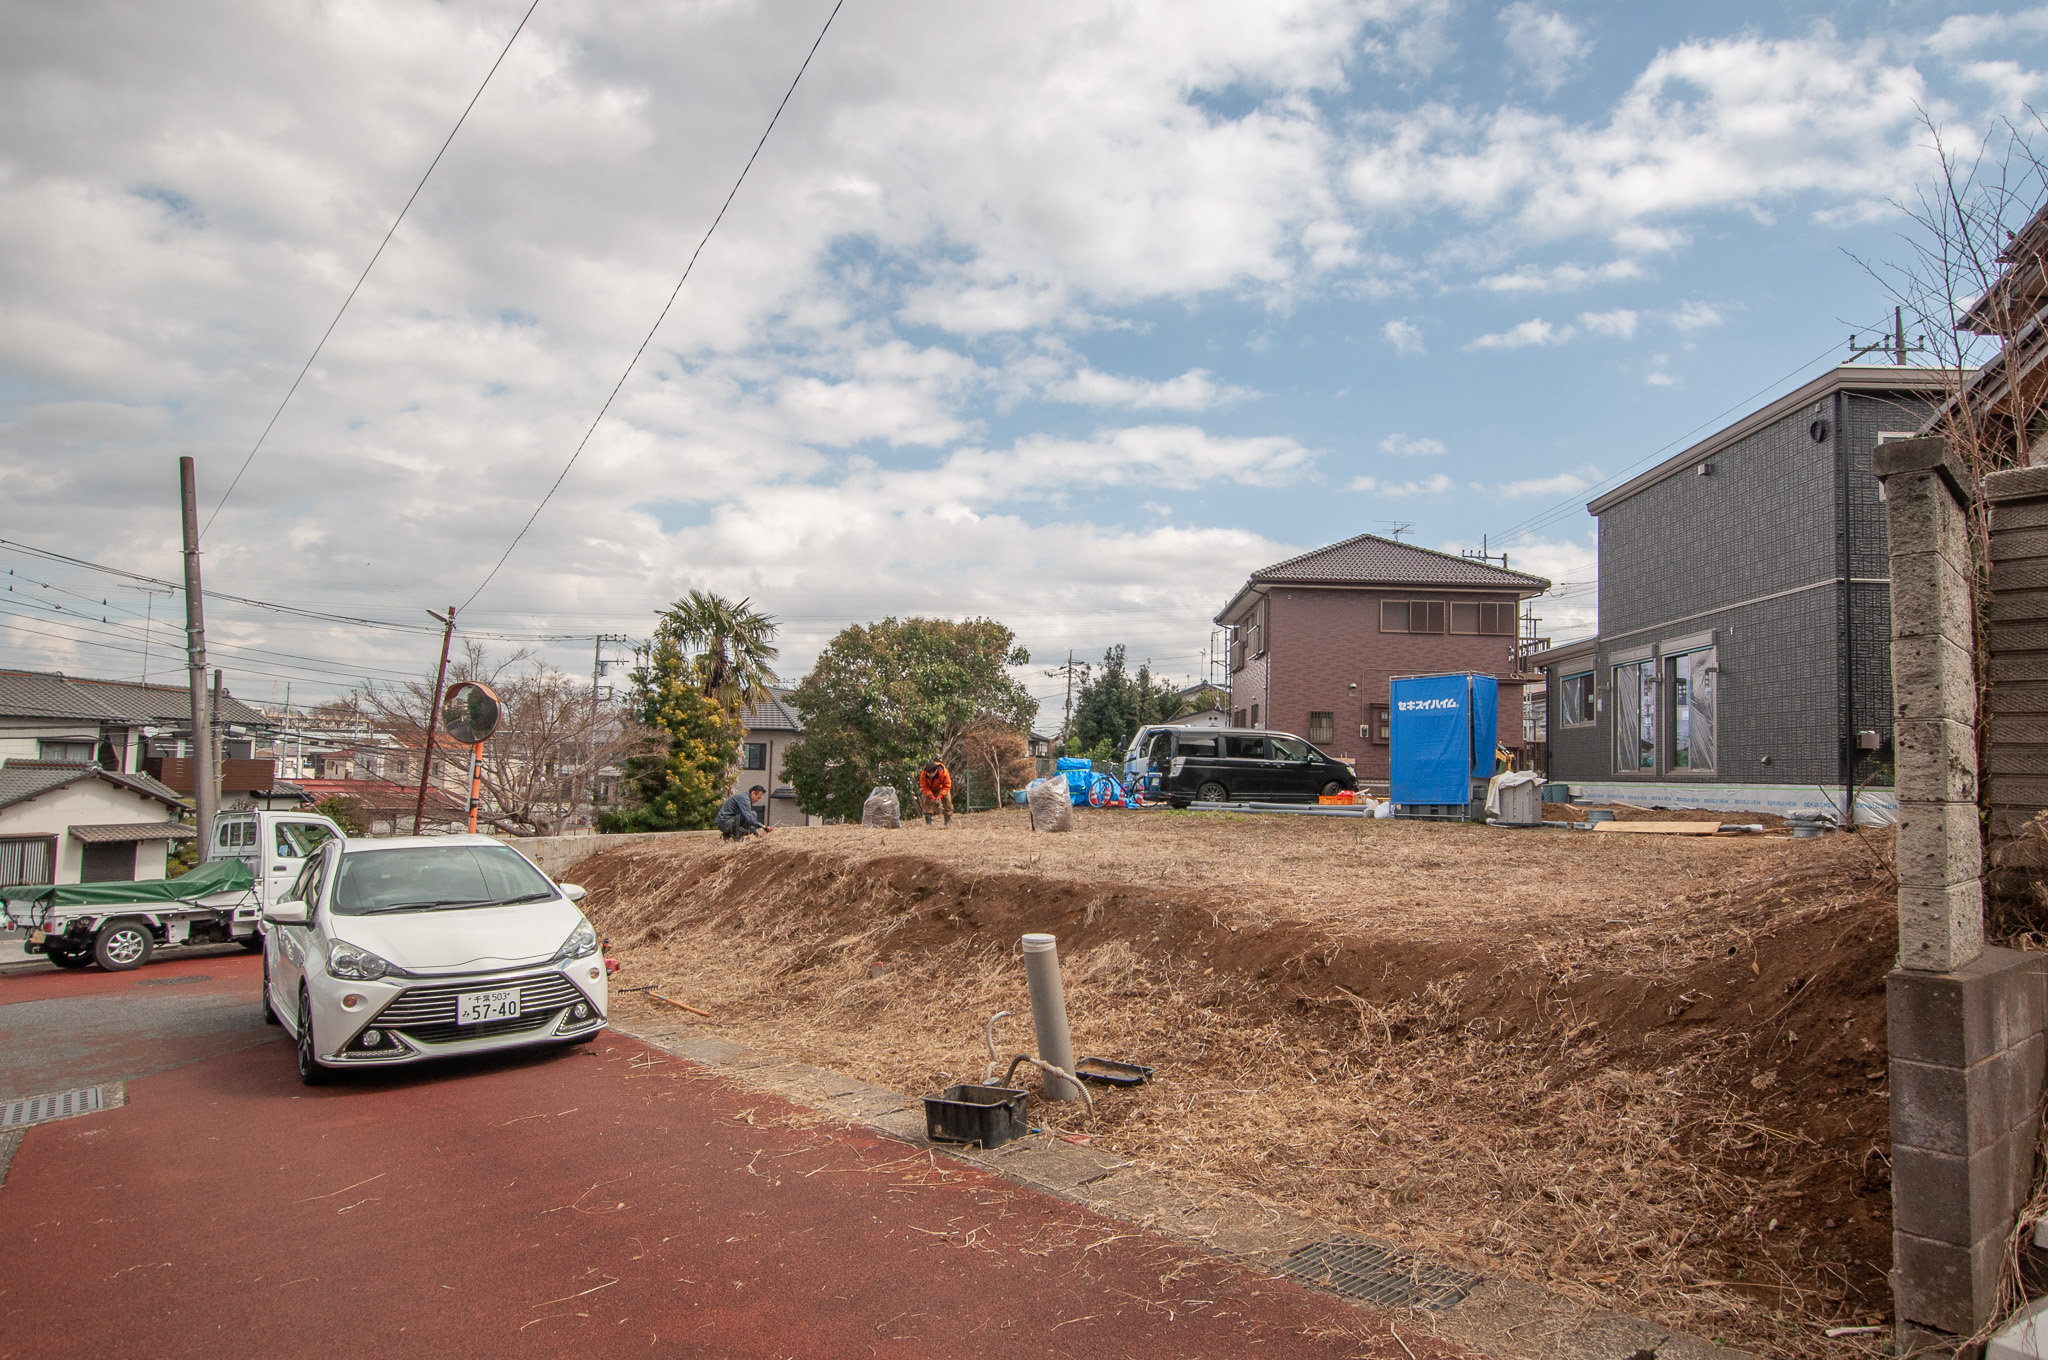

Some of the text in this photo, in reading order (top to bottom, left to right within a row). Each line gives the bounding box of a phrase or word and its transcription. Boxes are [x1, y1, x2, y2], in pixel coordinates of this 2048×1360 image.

[1398, 698, 1457, 711] セキスイハイム
[472, 1001, 517, 1020] 57-40
